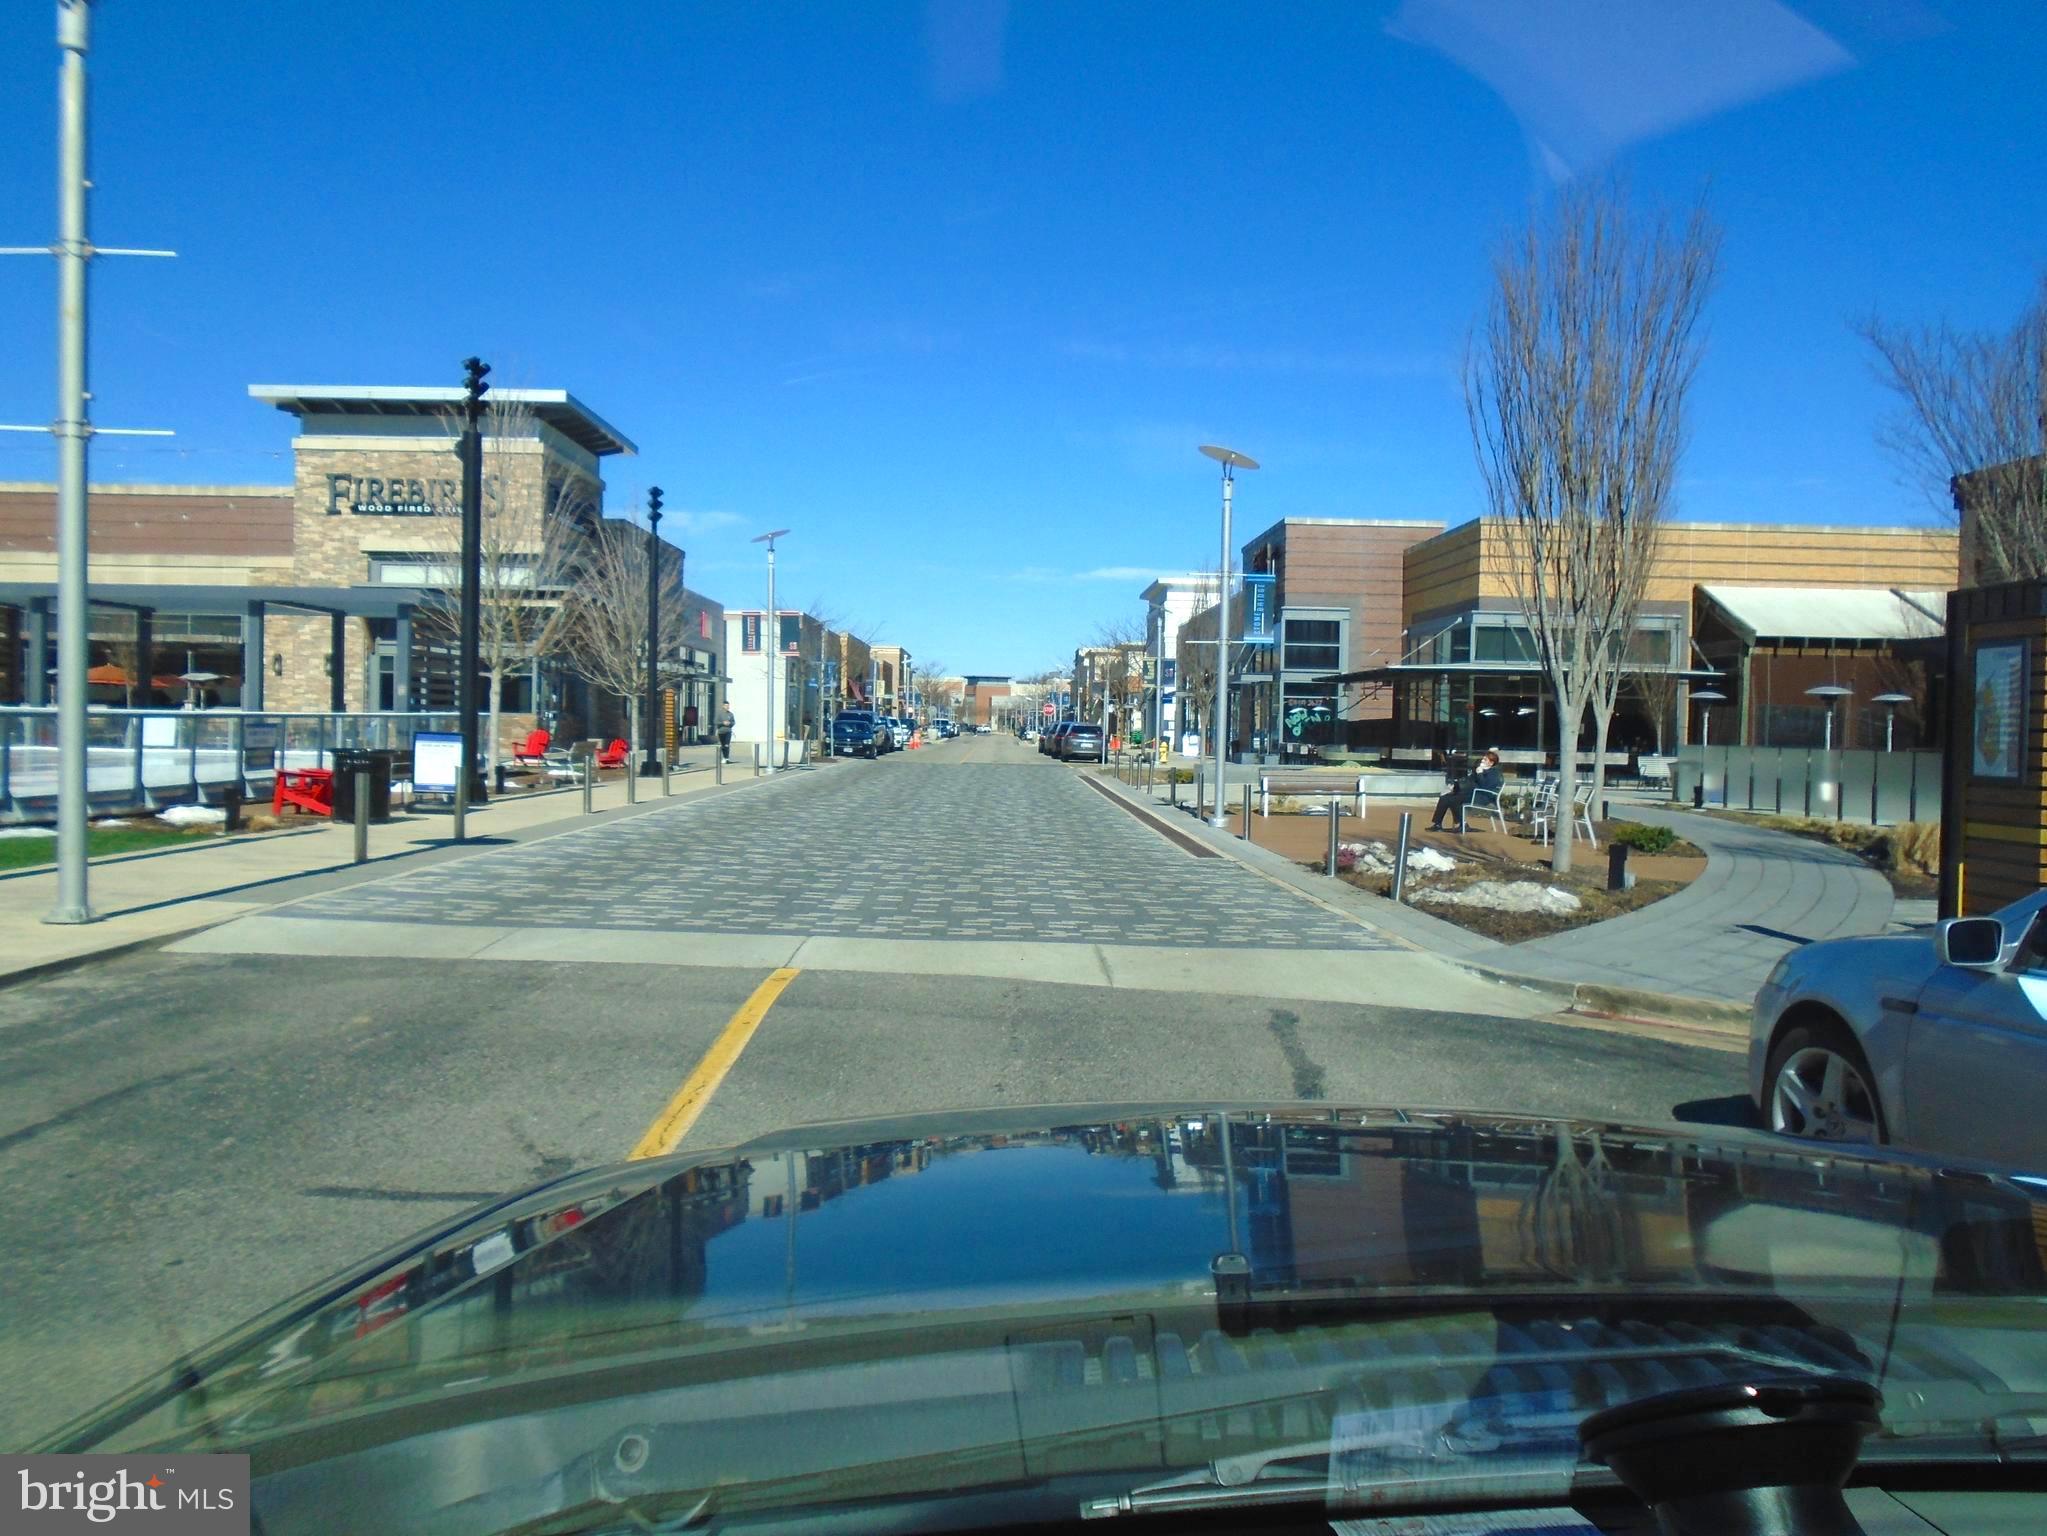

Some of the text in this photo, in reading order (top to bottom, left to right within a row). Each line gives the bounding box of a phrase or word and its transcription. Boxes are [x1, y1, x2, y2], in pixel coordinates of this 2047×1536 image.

[325, 473, 498, 518] FIREBIRS
[357, 504, 393, 513] WOOD
[397, 505, 432, 514] FIRED
